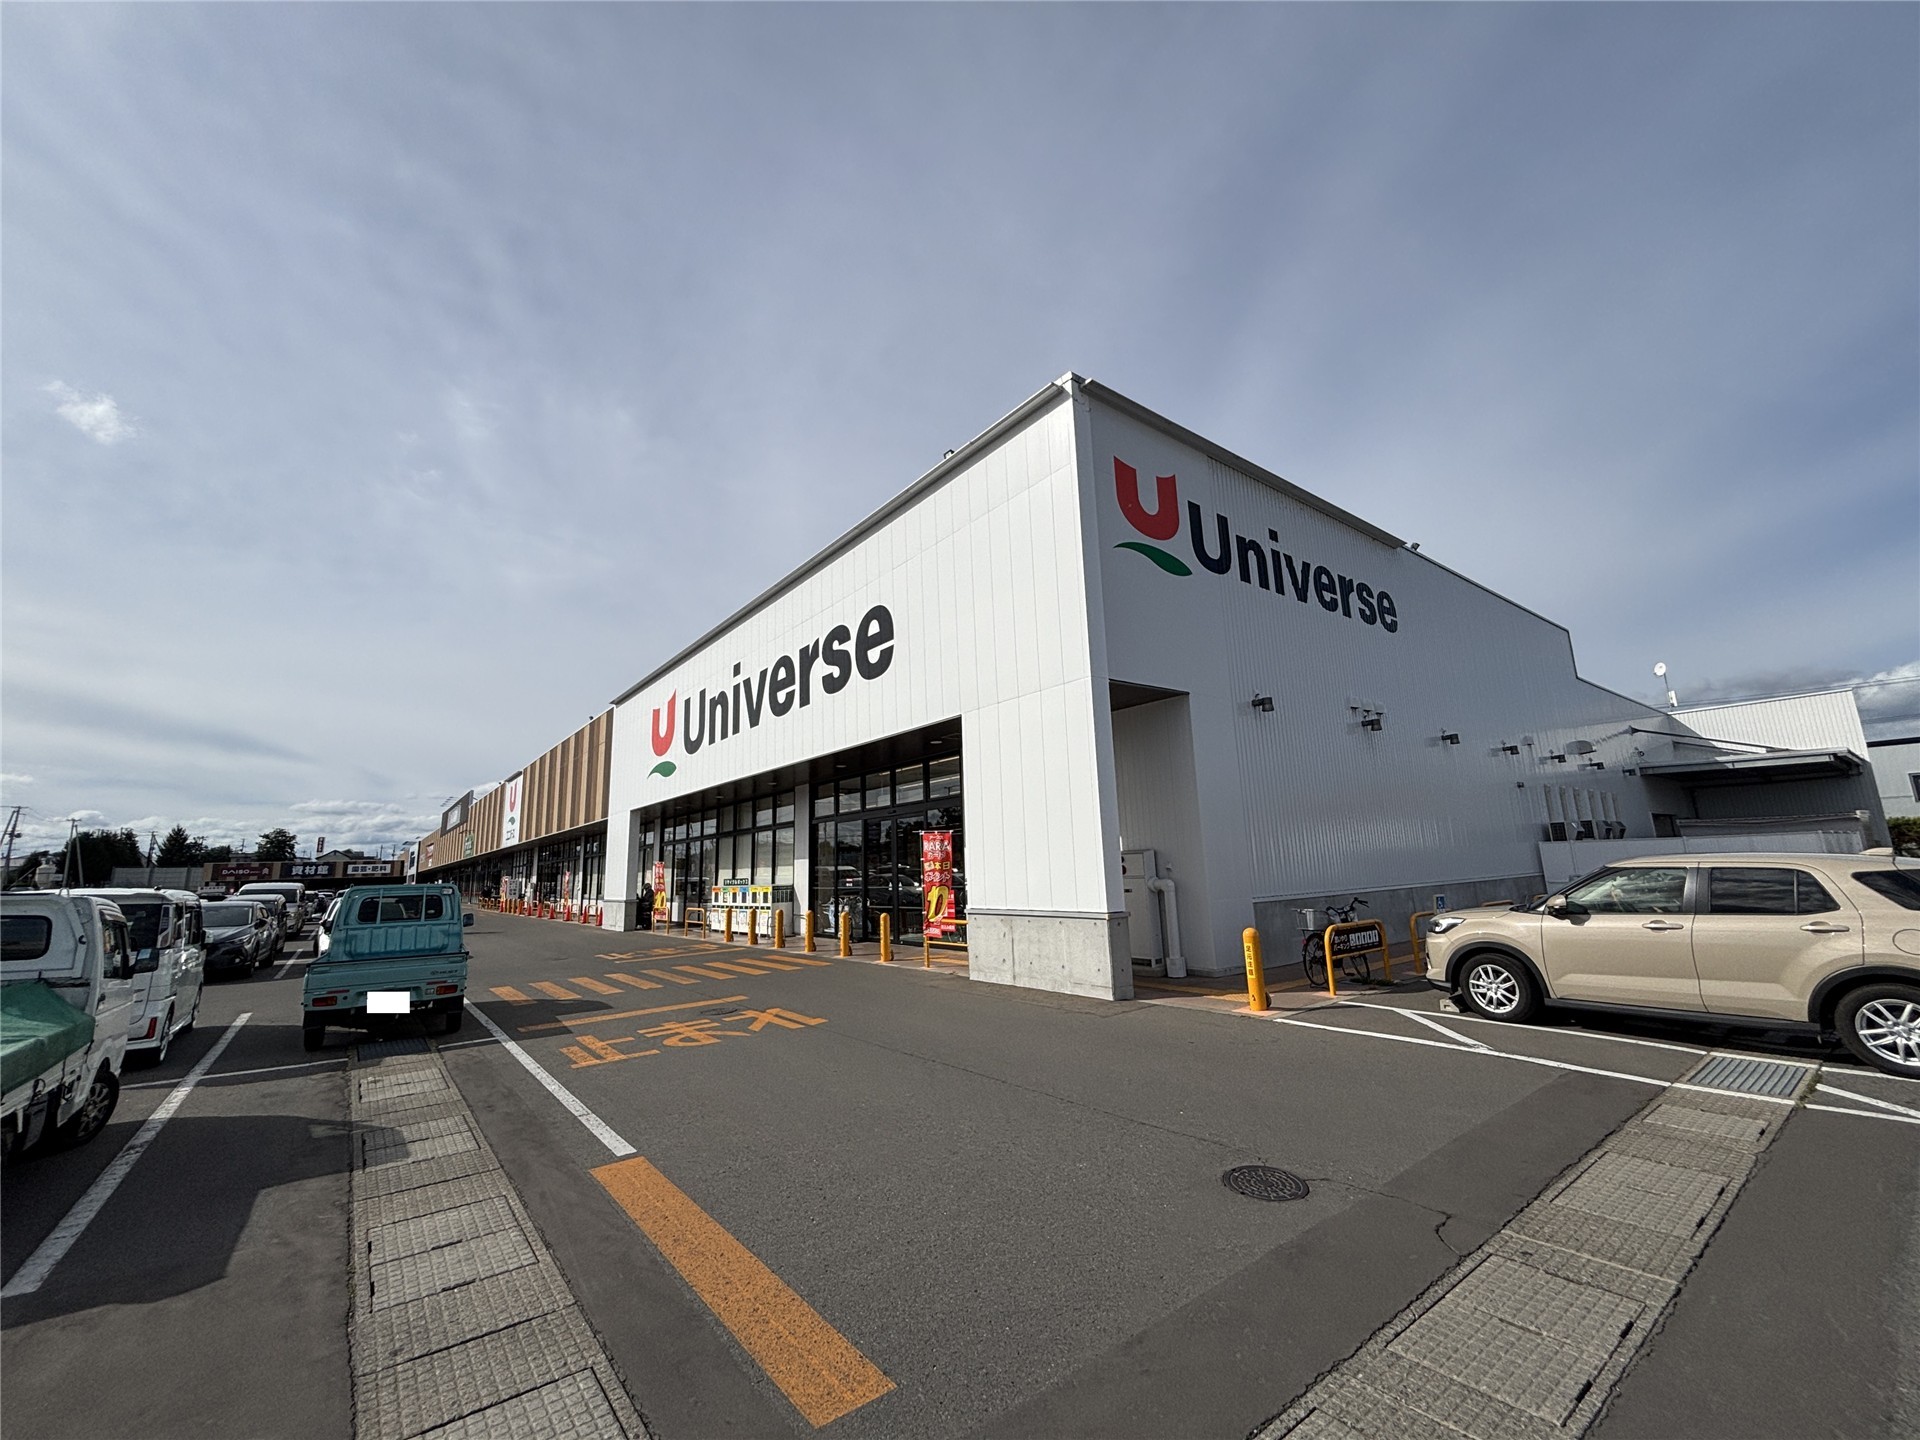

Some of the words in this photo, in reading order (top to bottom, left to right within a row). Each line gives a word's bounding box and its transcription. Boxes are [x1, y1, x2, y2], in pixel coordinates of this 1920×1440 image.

[1187, 501, 1398, 634] Universe
[683, 604, 895, 755] Universe
[290, 865, 329, 876] 資材館
[923, 840, 950, 851] RARA
[559, 1008, 828, 1069] 止まれ
